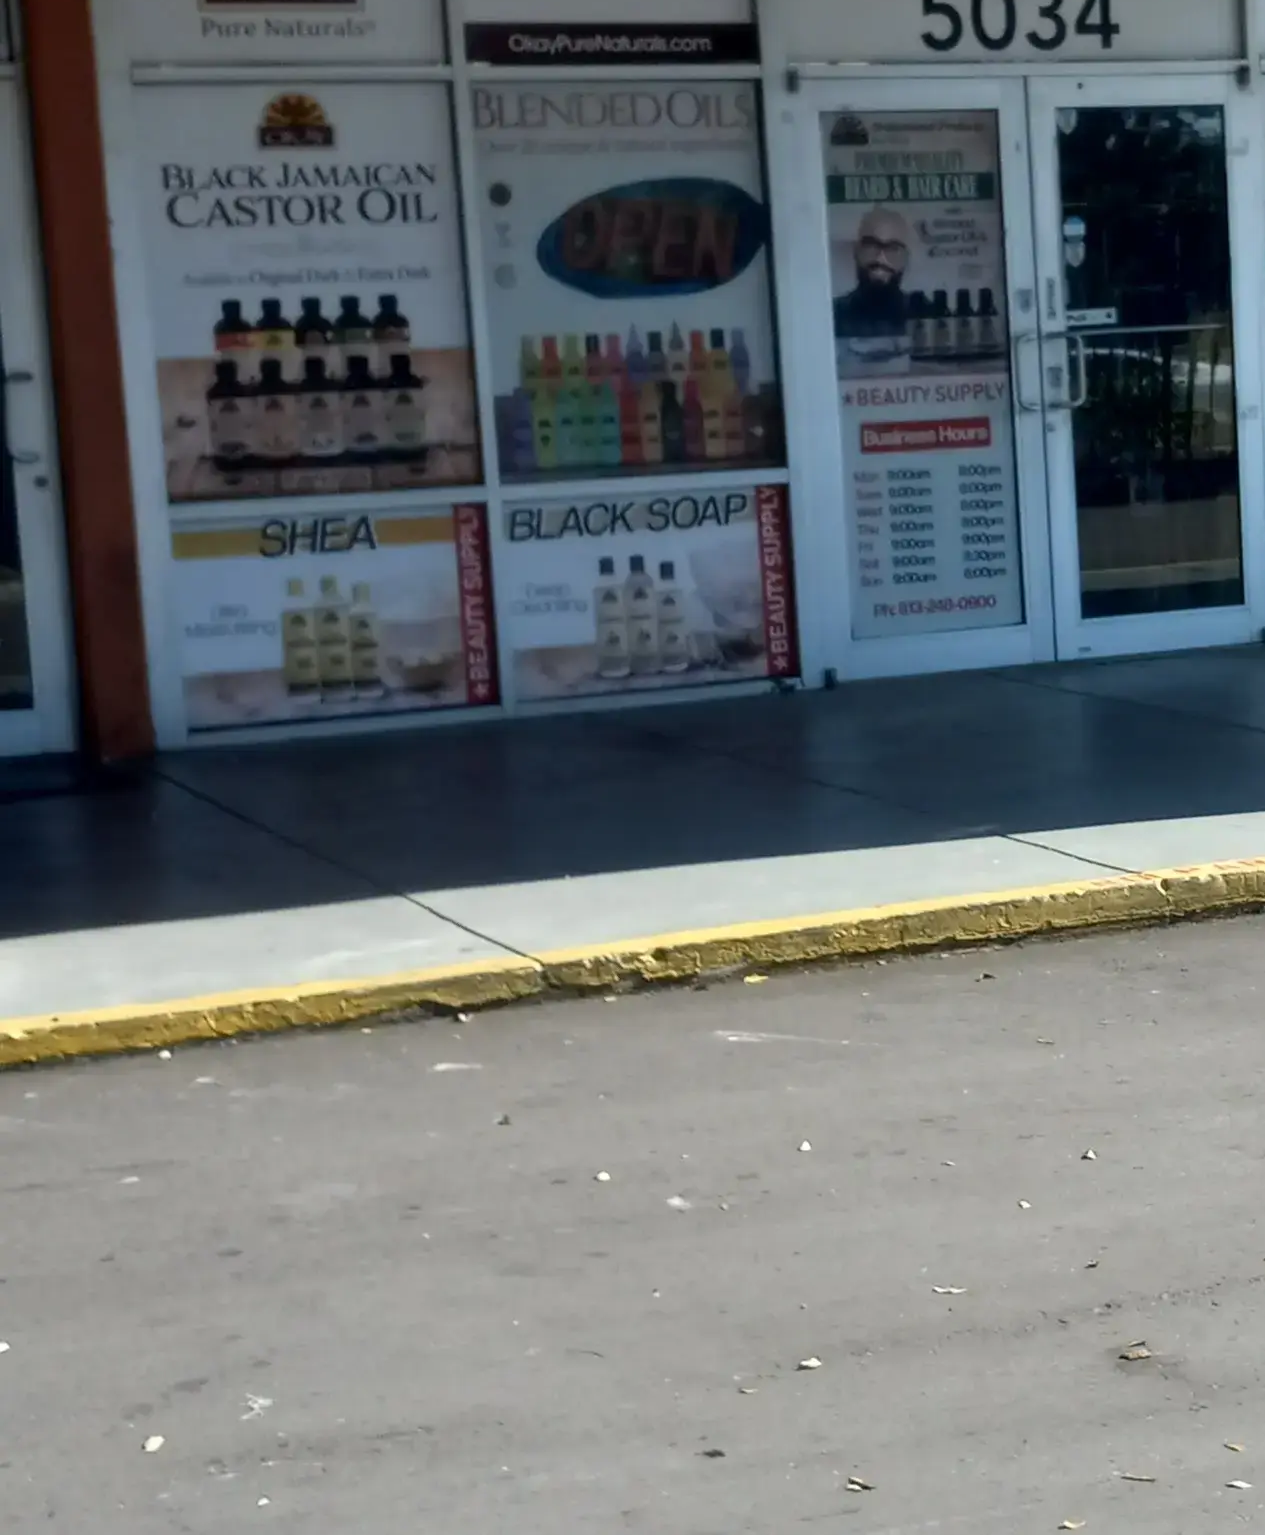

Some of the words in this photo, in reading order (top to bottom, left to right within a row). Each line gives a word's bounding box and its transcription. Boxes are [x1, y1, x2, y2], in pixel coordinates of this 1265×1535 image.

[201, 18, 256, 38] Pure
[508, 33, 713, 55] OkayPureNaturals.com
[161, 164, 267, 189] BLACK
[276, 162, 438, 188] JAMAICAN
[166, 190, 346, 228] CASTOR
[356, 187, 438, 225] OIL
[856, 385, 931, 407] BEAUTY
[935, 381, 1004, 403] SUPPLY
[260, 515, 378, 558] SHEA
[509, 502, 636, 543] BLACK
[646, 493, 748, 533] SOAP
[760, 487, 784, 567] SUPPLY
[765, 570, 789, 662] BEAUTY
